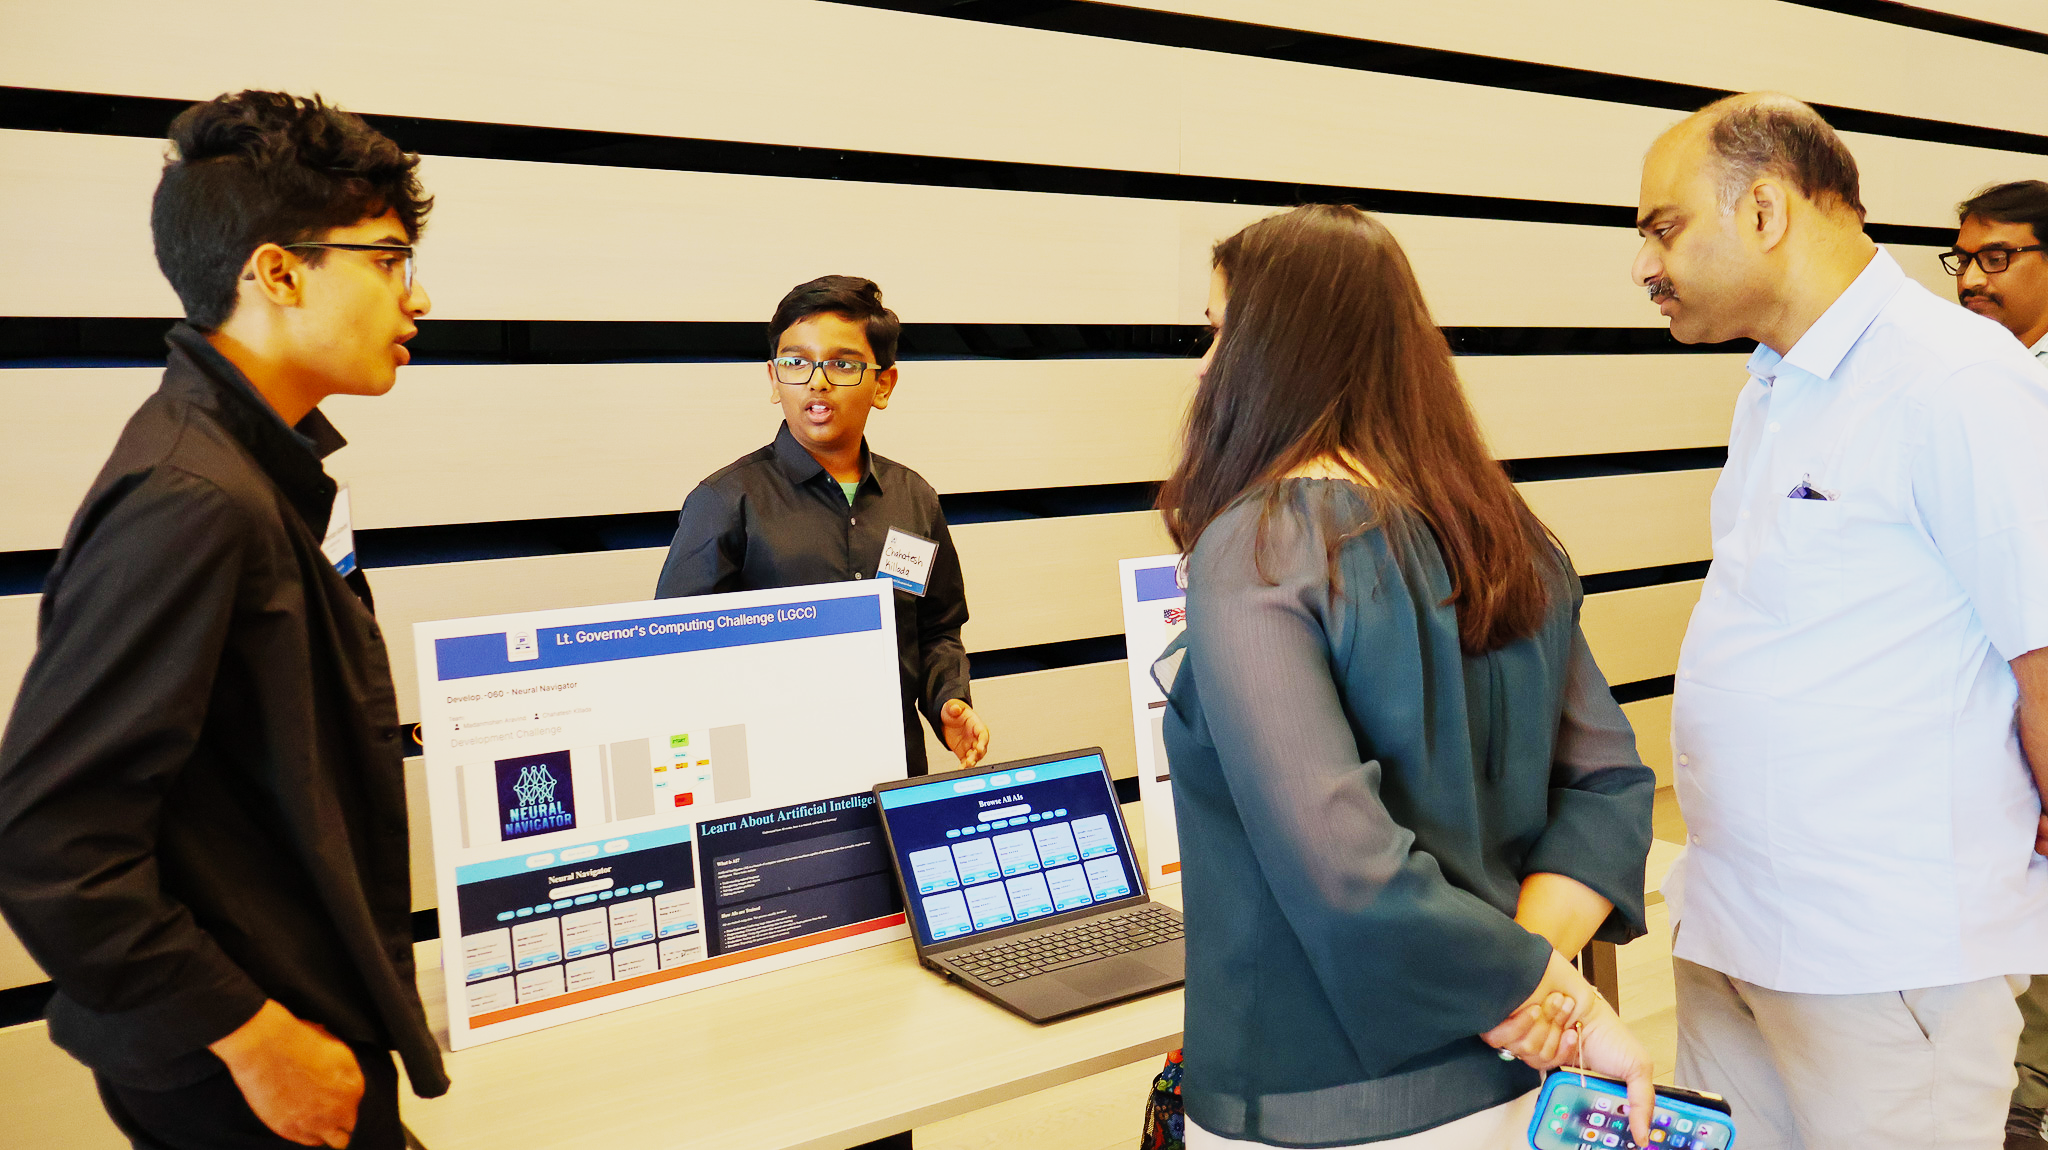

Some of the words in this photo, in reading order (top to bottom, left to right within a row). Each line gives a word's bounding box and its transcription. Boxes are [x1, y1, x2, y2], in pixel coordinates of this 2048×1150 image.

[556, 633, 573, 646] Lt.
[576, 625, 646, 643] Governor's
[648, 618, 715, 635] Computing
[717, 613, 774, 628] Challenge
[777, 605, 817, 622] (LGCC)
[512, 686, 538, 696] Neural
[540, 681, 578, 692] Navigator
[451, 732, 513, 748] Development
[516, 726, 562, 739] Challenge
[978, 798, 1002, 808] Browse
[1002, 795, 1012, 804] All
[1012, 793, 1024, 801] AIs
[510, 801, 566, 822] NEURAL
[701, 821, 737, 836] Learn
[740, 812, 775, 829] About
[777, 802, 827, 821] Artificial
[505, 813, 572, 835] NAVIGATOR
[548, 872, 574, 884] Neural
[575, 866, 612, 878] Navigator
